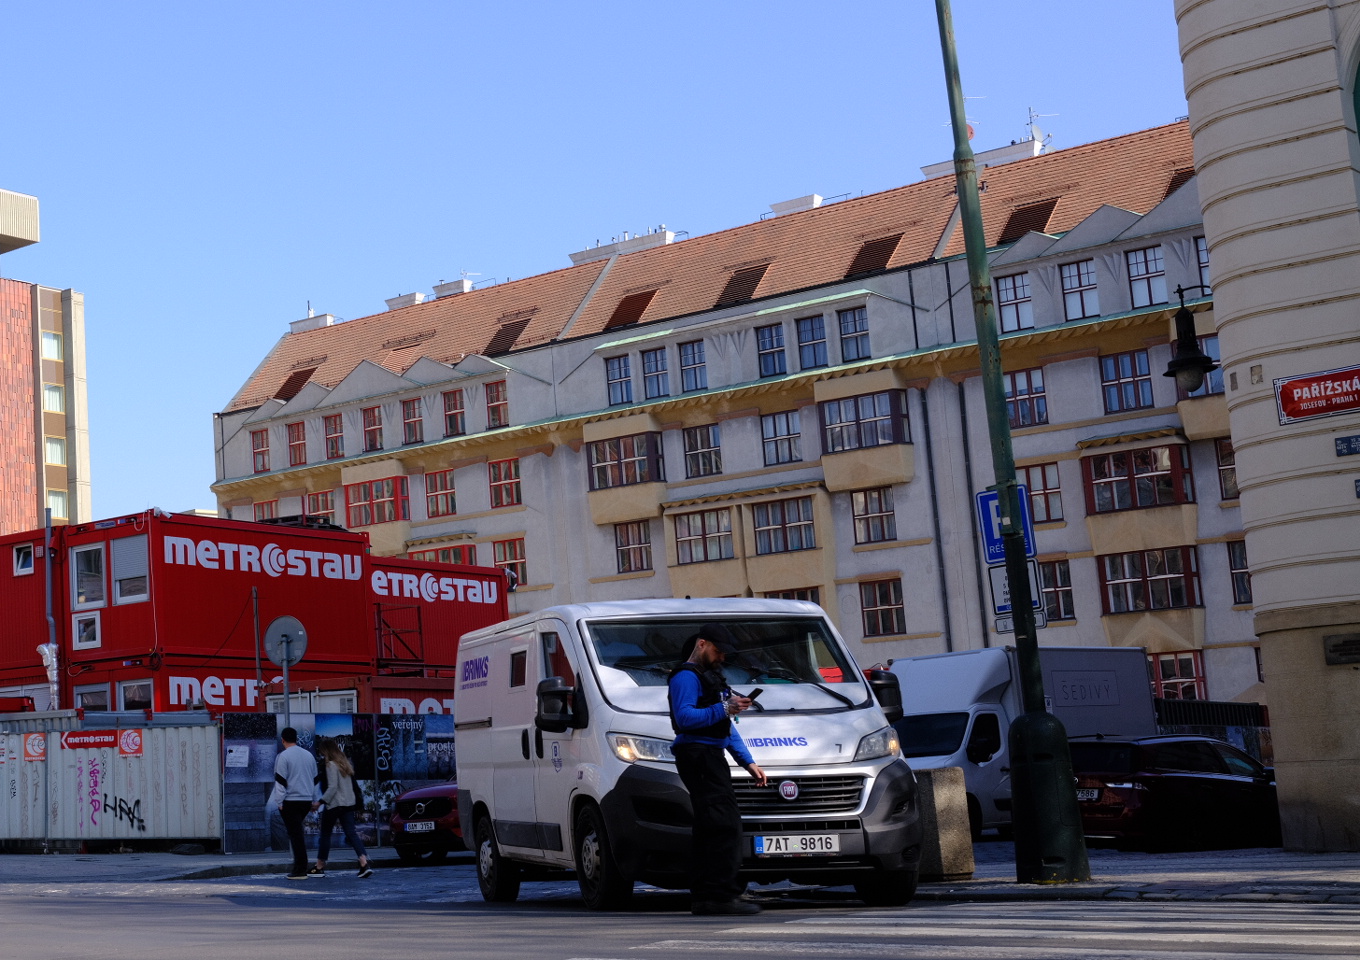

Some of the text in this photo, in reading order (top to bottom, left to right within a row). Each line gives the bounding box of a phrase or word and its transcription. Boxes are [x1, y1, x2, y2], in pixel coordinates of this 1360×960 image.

[1293, 375, 1360, 401] PAŘÍŽSKÁ
[1300, 399, 1327, 410] JOSEFOV
[1332, 396, 1354, 405] PRAHA
[464, 655, 489, 681] BRINKS
[392, 719, 423, 732] veřejný
[753, 737, 808, 748] BRINKS
[783, 785, 795, 795] FIAT
[765, 837, 789, 852] 7AT
[800, 836, 833, 851] 9816
